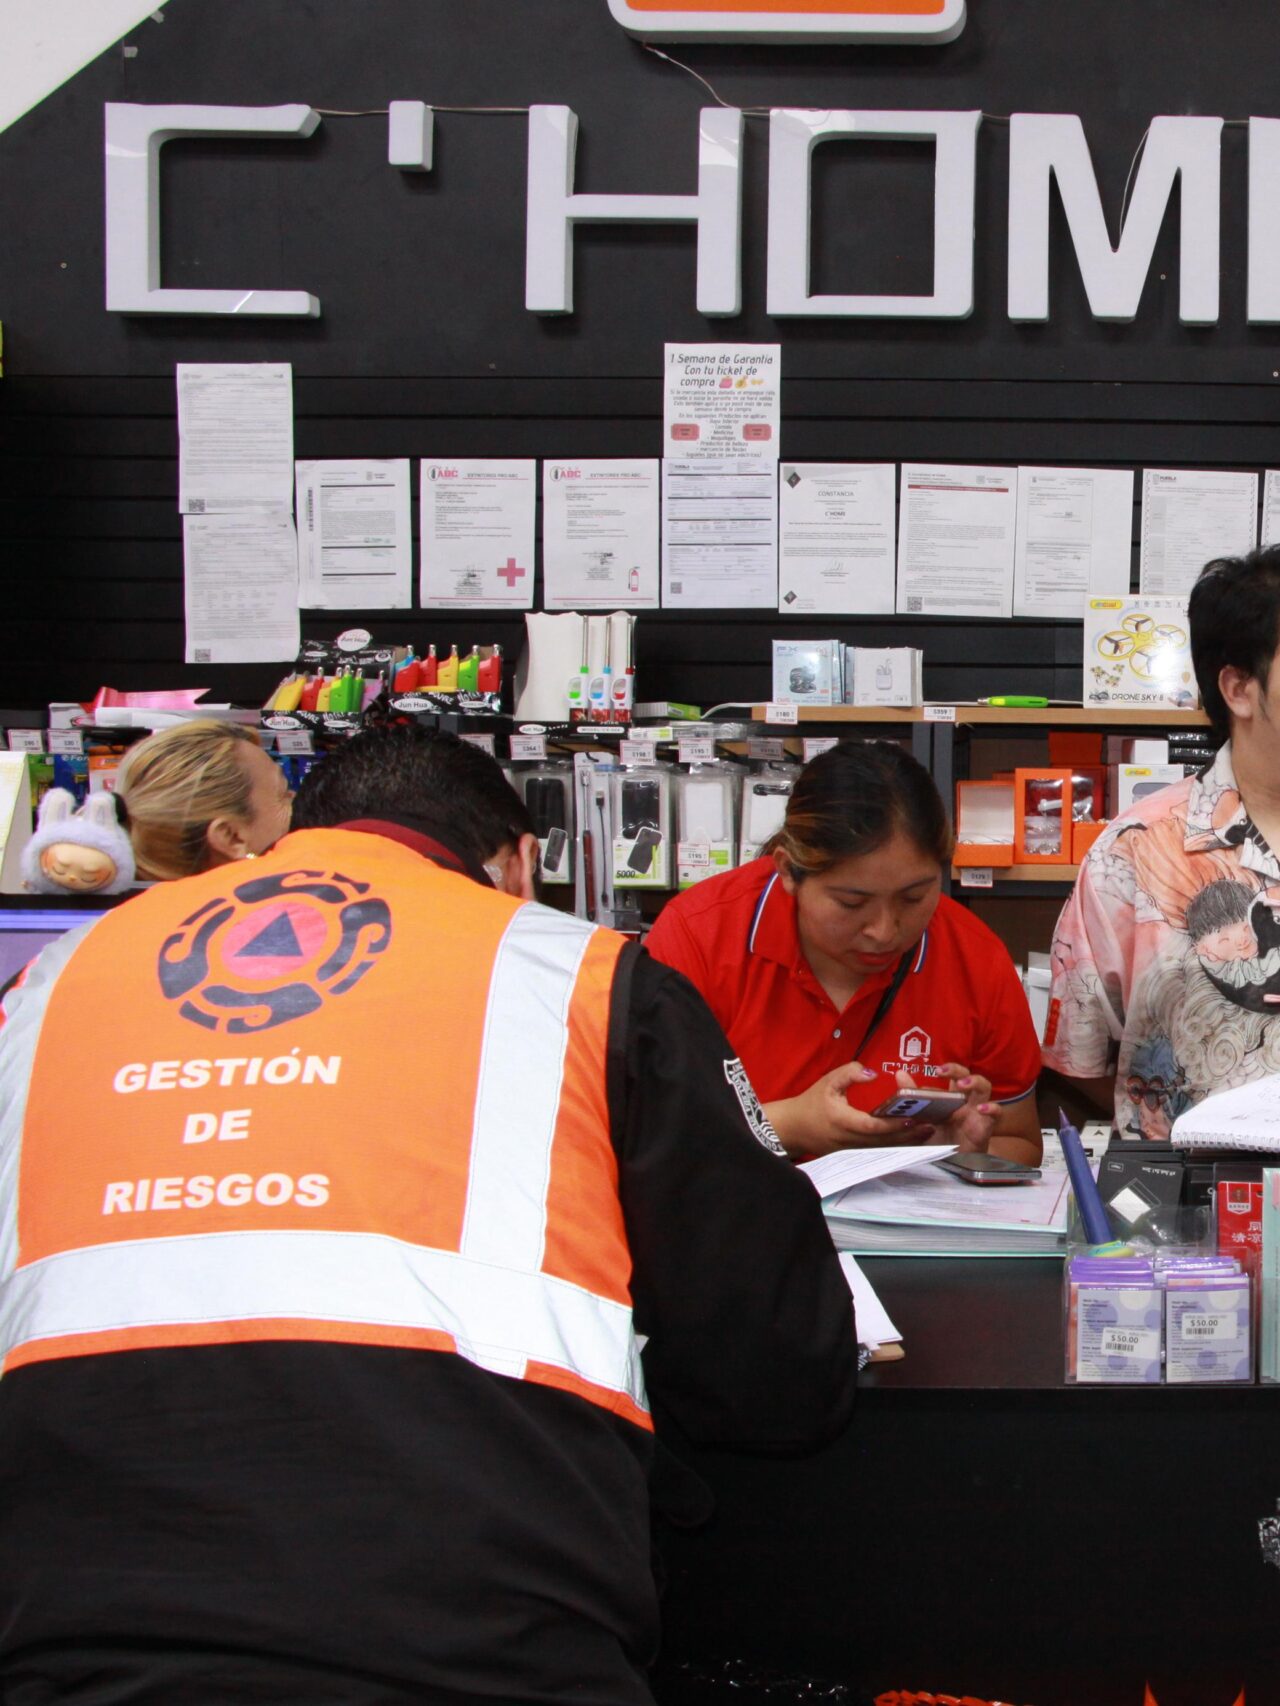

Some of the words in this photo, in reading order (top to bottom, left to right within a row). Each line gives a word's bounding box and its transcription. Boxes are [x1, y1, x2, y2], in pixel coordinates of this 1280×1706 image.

[677, 353, 716, 364] Semana
[719, 354, 730, 364] de
[685, 365, 702, 375] Con
[704, 366, 714, 375] tu
[716, 366, 743, 376] ticket
[746, 366, 758, 376] de
[680, 378, 716, 389] compra
[437, 469, 459, 478] ABC
[560, 470, 581, 478] ABC
[1111, 693, 1140, 701] DRONE
[1142, 693, 1157, 701] SKY
[398, 701, 412, 709] Jun
[413, 701, 428, 709] Hua
[615, 870, 636, 878] 5000
[113, 1047, 342, 1094] GESTIÓN
[182, 1109, 252, 1145] DE
[101, 1171, 330, 1216] RIESGOS
[1190, 1319, 1218, 1327] $50.00
[1111, 1334, 1139, 1344] $50.00
